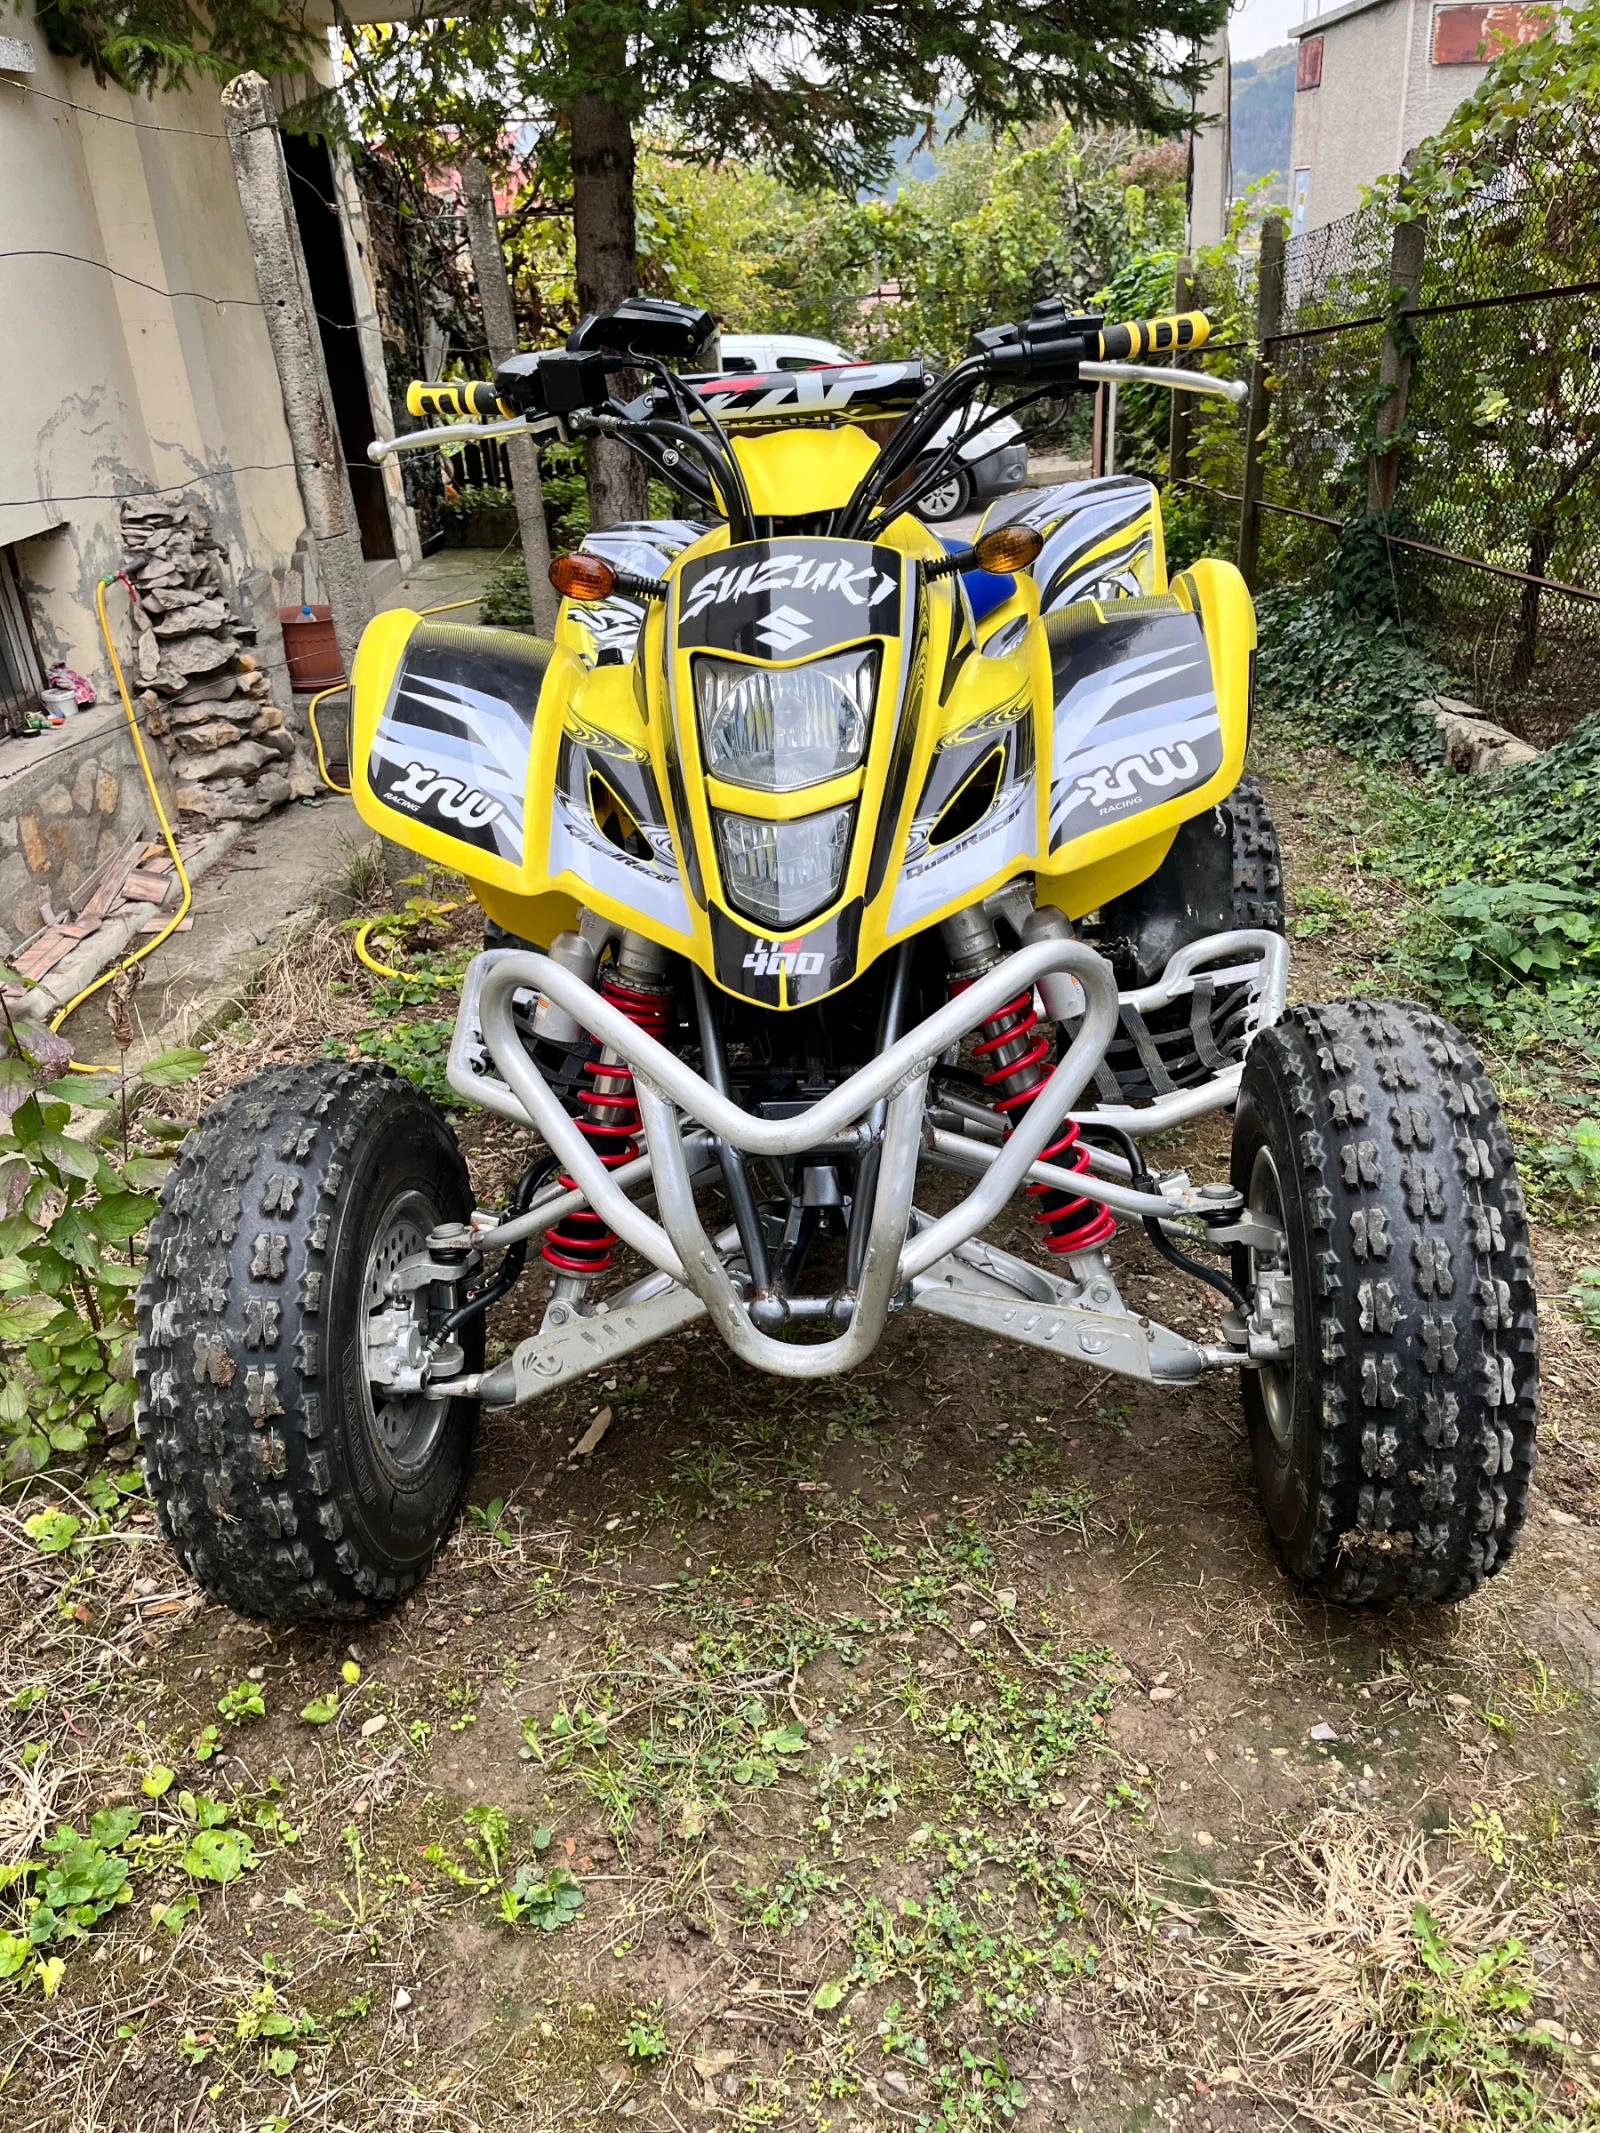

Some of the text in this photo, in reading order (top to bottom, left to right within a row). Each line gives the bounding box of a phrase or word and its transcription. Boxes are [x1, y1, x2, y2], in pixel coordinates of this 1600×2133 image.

[679, 555, 898, 624] SUZUKI
[383, 792, 421, 813] RACING
[1099, 796, 1142, 816] RACING
[564, 824, 680, 883] QuadRacer
[906, 807, 1020, 881] QuadRacer
[742, 952, 825, 976] 400
